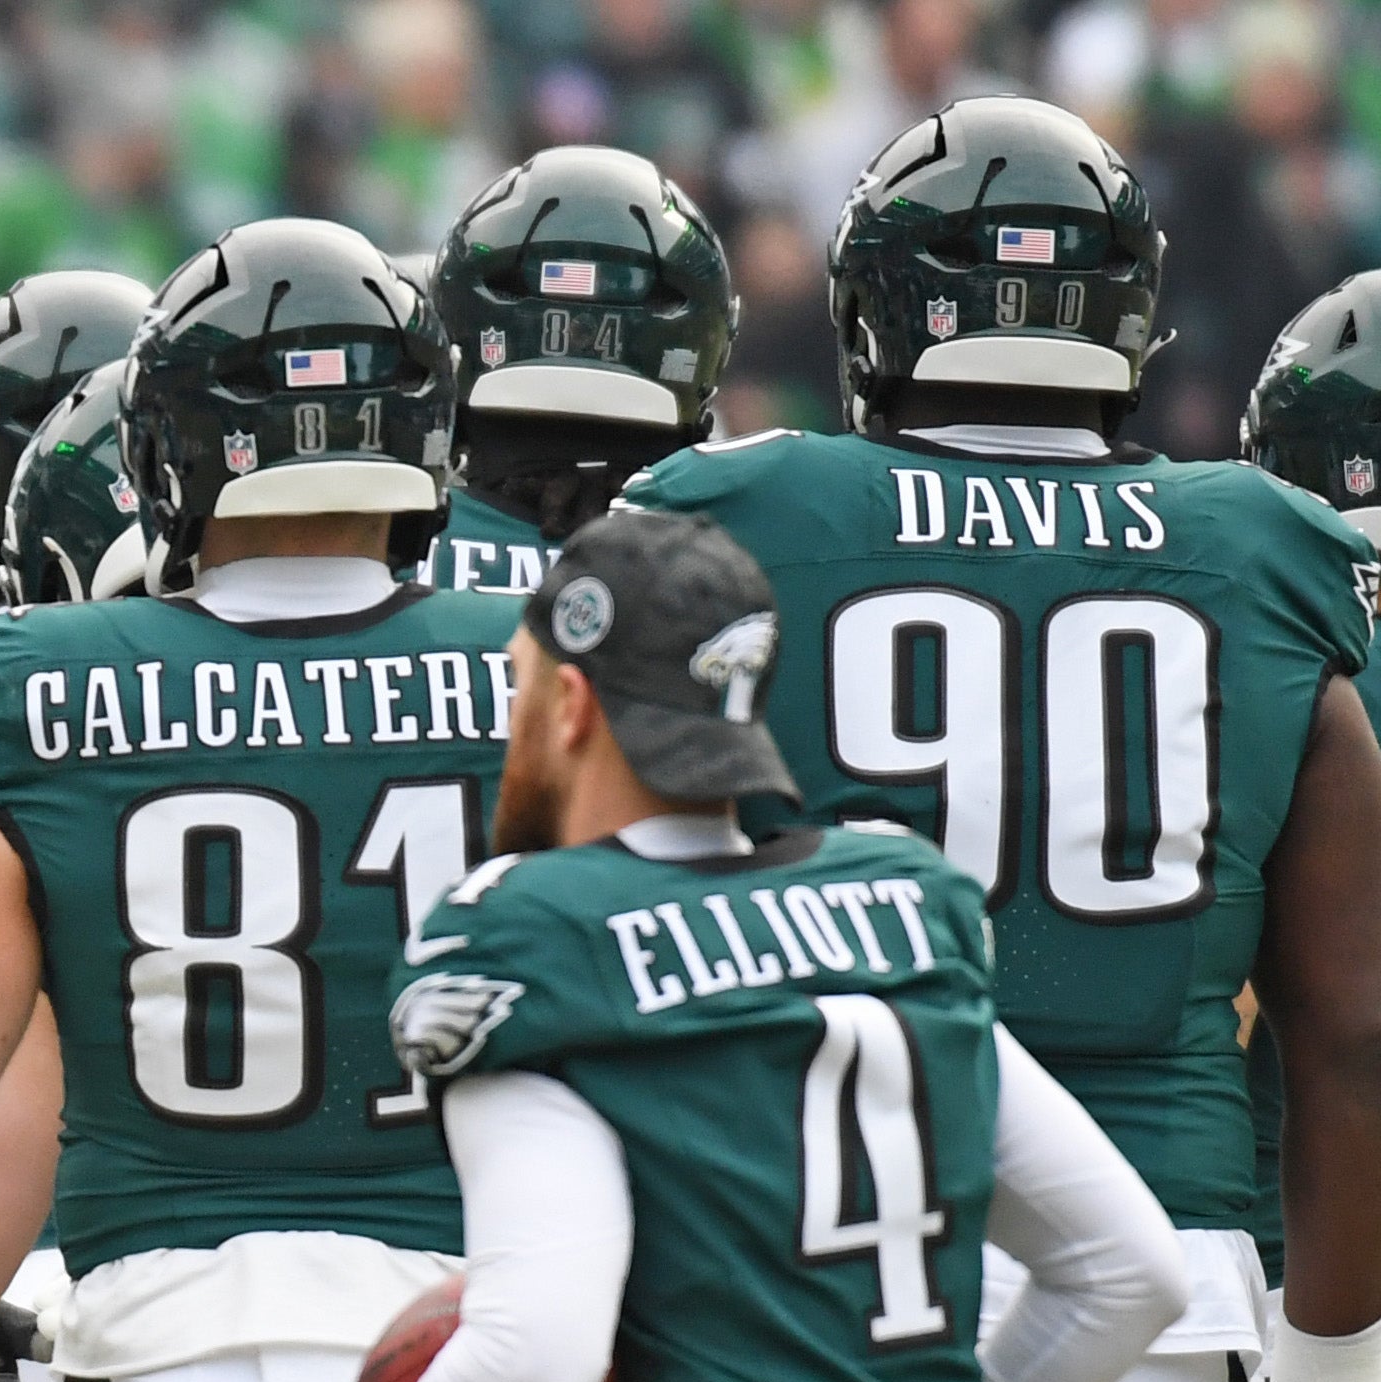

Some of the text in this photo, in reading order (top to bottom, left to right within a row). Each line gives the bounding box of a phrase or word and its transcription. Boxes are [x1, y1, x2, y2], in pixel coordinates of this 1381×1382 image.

[932, 316, 953, 332] NFL
[889, 466, 1164, 550] DAVIS
[1349, 473, 1372, 490] NFL
[834, 588, 1214, 916] 90
[121, 779, 477, 1124] 81
[606, 878, 935, 1014] ELLIOTT
[801, 995, 948, 1347] 4
